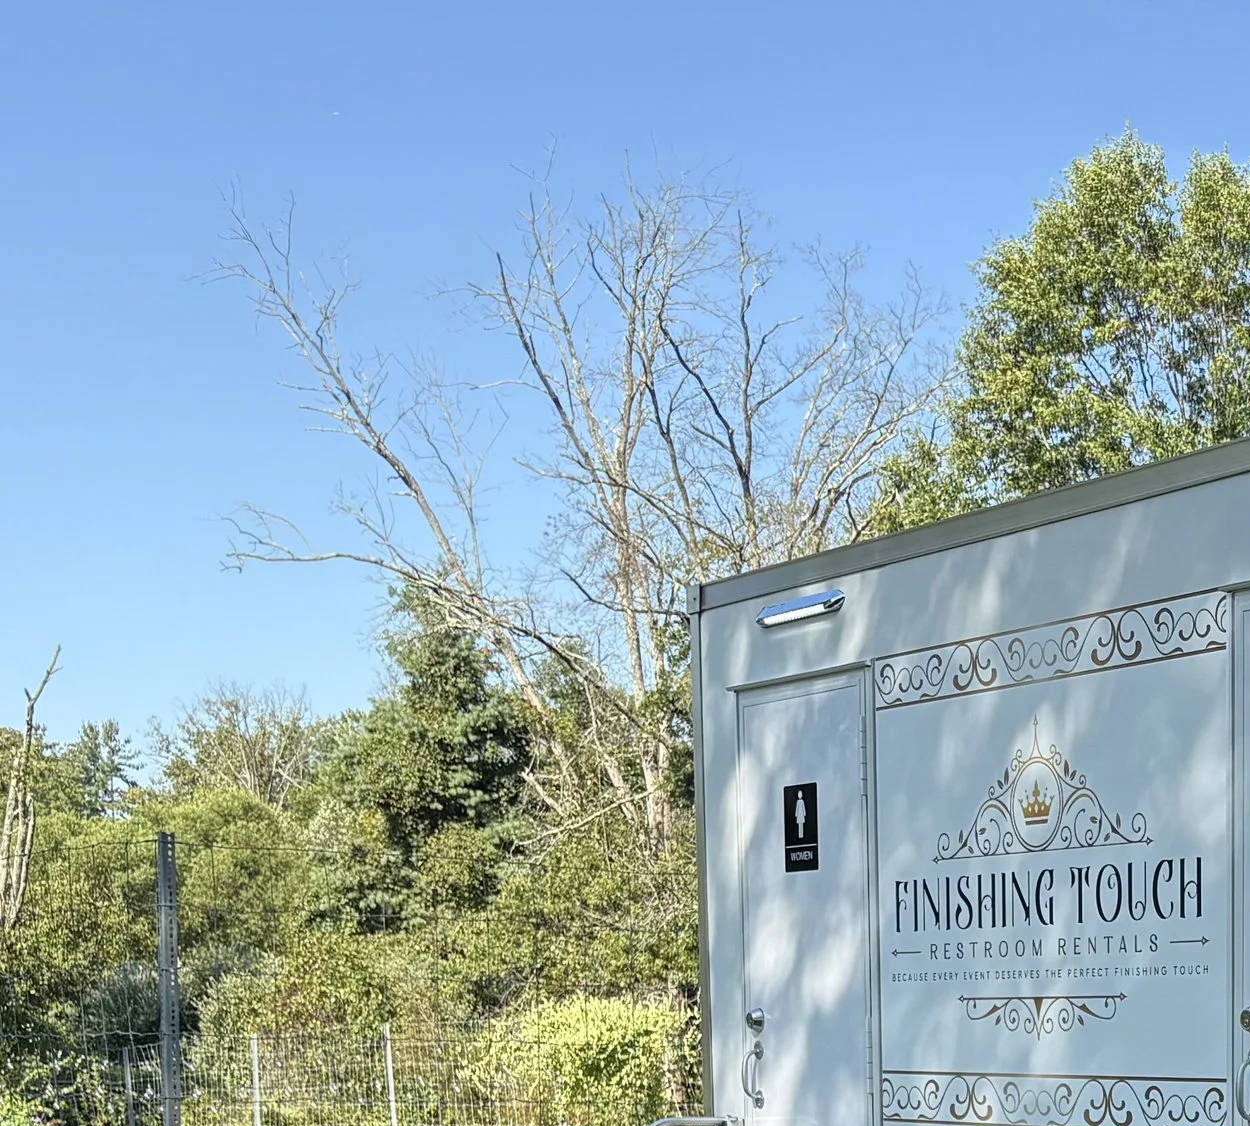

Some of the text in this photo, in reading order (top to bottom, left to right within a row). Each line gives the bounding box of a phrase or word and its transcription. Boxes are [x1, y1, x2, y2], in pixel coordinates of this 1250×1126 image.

[790, 850, 813, 861] WOMEN
[895, 856, 1202, 933] FINISHING TOUCH
[930, 933, 1159, 960] RESTROOM RENTALS
[892, 965, 1209, 982] BECAUSE EVERY EVENT DESERVES THE PERFECT FINISHING TOUCH
